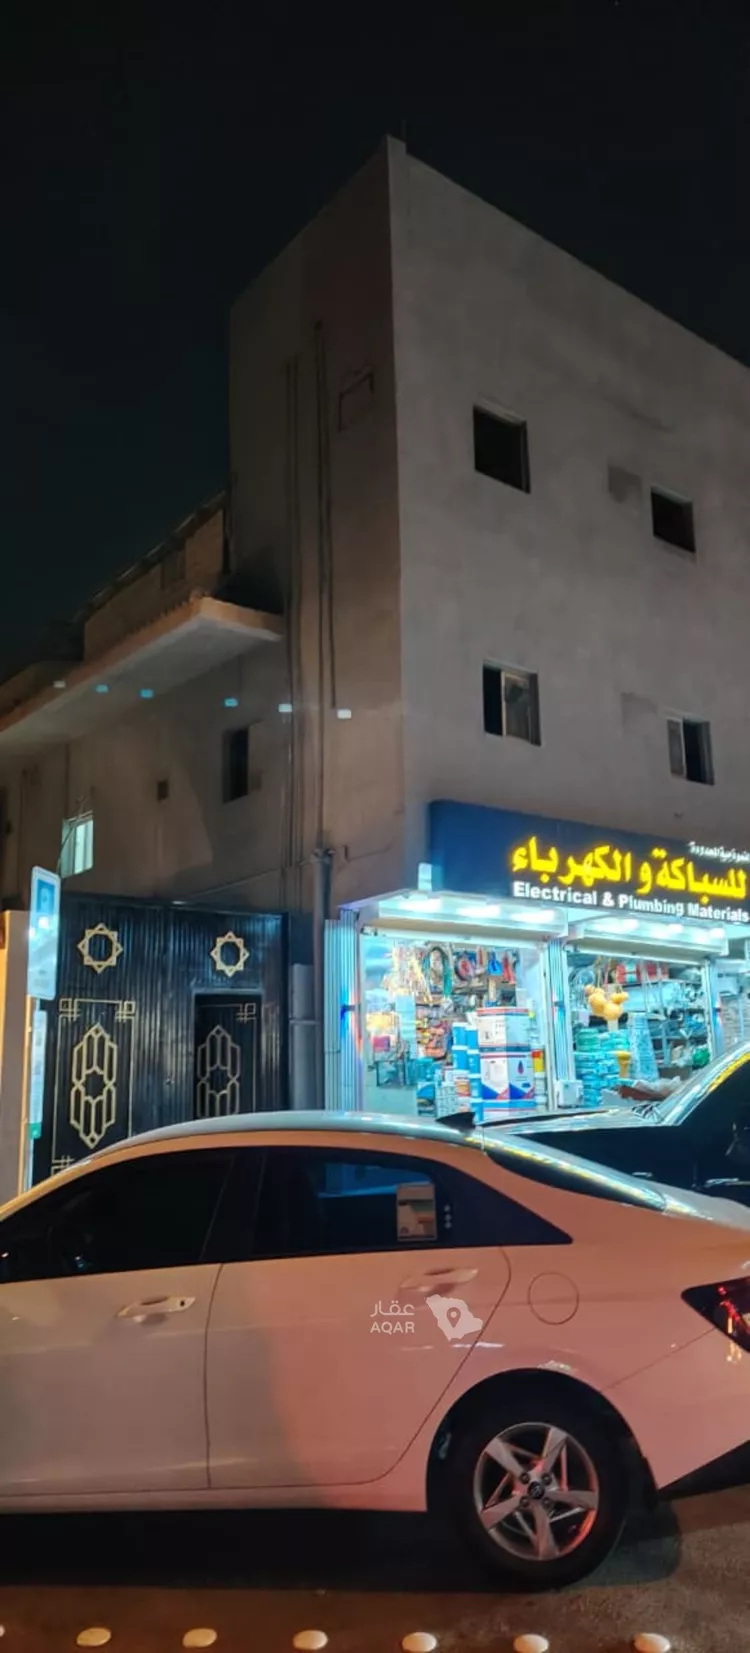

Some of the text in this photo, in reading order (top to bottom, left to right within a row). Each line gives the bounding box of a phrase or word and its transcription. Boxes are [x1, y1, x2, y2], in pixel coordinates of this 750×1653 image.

[511, 836, 746, 905] للسباكة و الكهرباء
[513, 881, 749, 922] Electrical & Plumbing Materials
